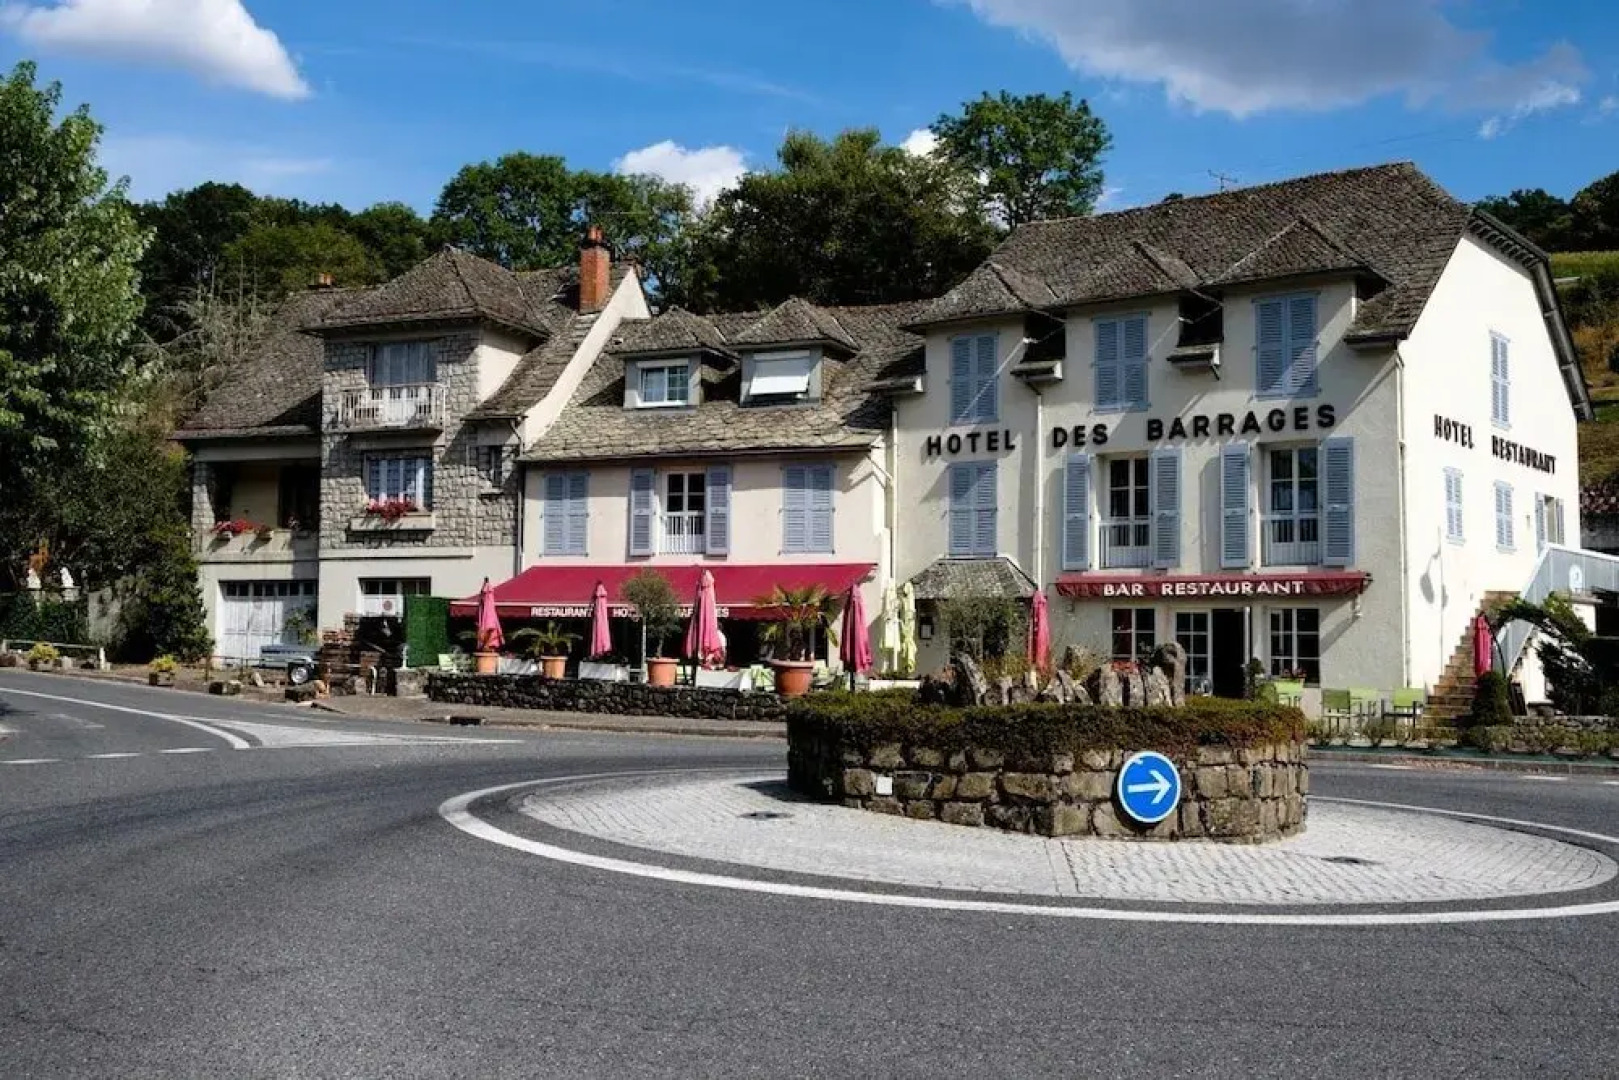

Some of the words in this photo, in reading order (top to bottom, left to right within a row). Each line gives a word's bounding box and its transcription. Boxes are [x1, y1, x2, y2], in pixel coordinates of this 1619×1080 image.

[926, 429, 1016, 456] HOTEL
[1052, 423, 1109, 449] DES
[1146, 404, 1337, 442] BARRAGES
[1434, 414, 1475, 450] HOTEL
[1491, 434, 1557, 475] RESTAURANT
[1103, 583, 1144, 597] BAR
[1161, 580, 1304, 596] RESTAURANT
